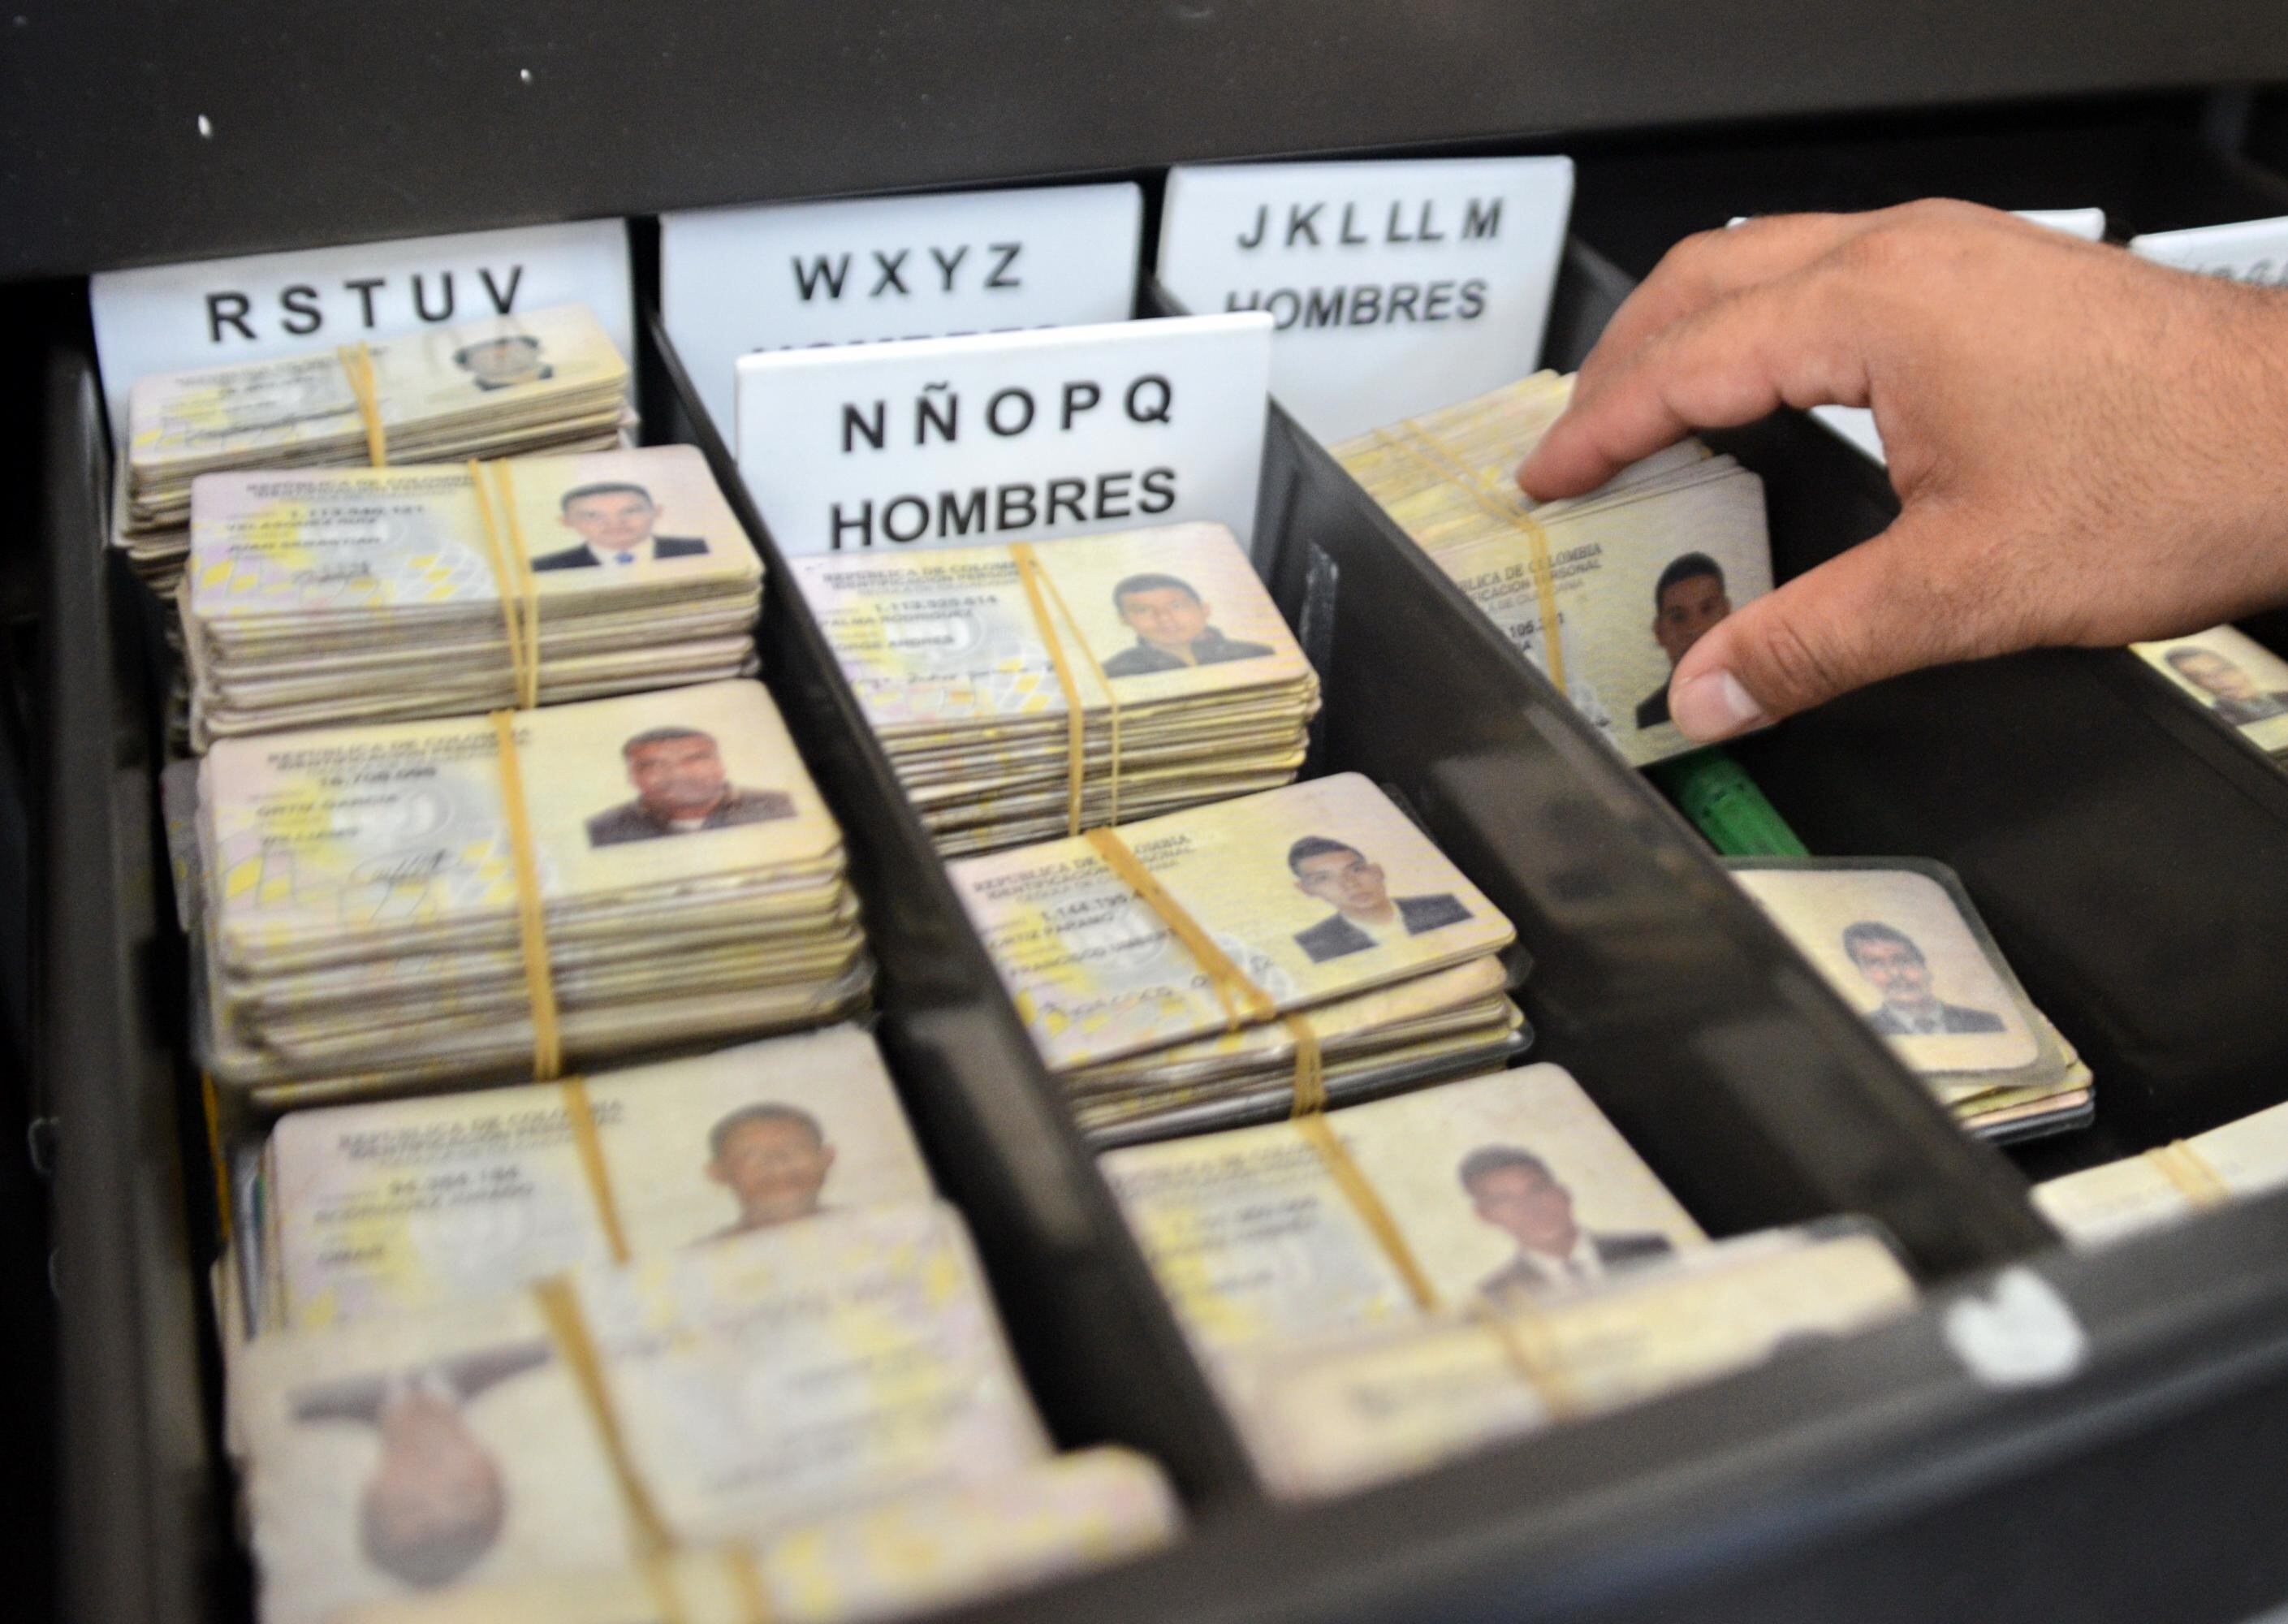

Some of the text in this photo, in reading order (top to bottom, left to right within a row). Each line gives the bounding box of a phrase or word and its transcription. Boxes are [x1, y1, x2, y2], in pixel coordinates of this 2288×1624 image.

[1237, 196, 1503, 249] J K L LL M
[205, 265, 522, 343] R S T U V
[792, 242, 1024, 302] W X Y Z
[842, 375, 1173, 453] N Ñ O P Q
[830, 466, 1177, 551] HOMBRES
